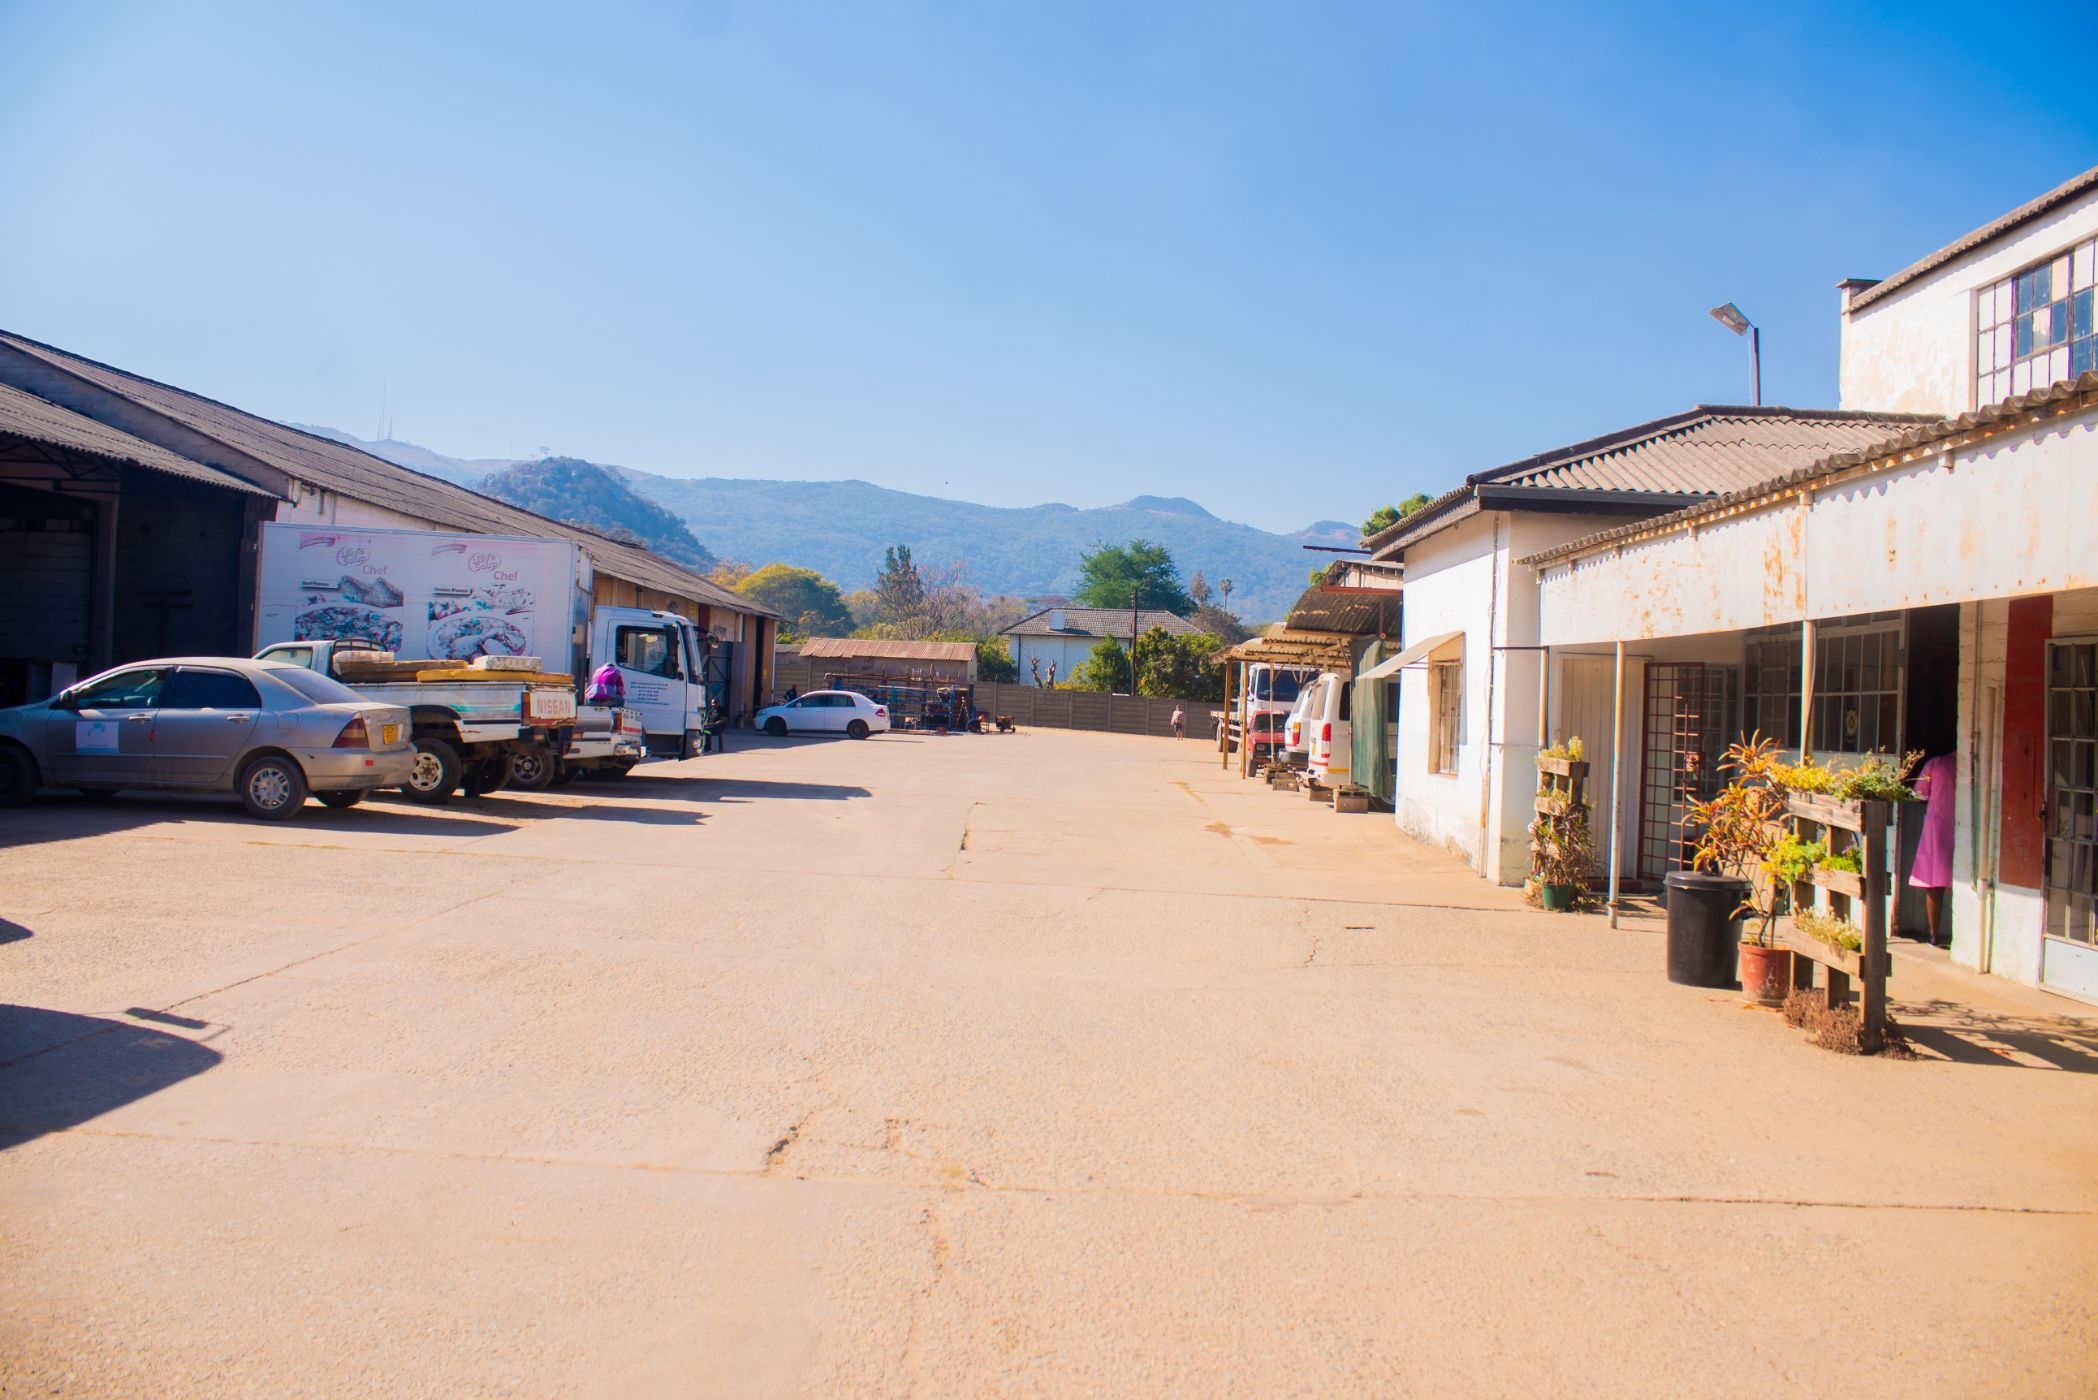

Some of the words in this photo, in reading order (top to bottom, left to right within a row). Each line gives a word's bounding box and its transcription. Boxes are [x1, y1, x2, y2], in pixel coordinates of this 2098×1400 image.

[363, 565, 388, 575] Chef
[473, 562, 498, 572] Soup
[493, 571, 519, 581] Chef
[537, 699, 571, 714] NISSAN
